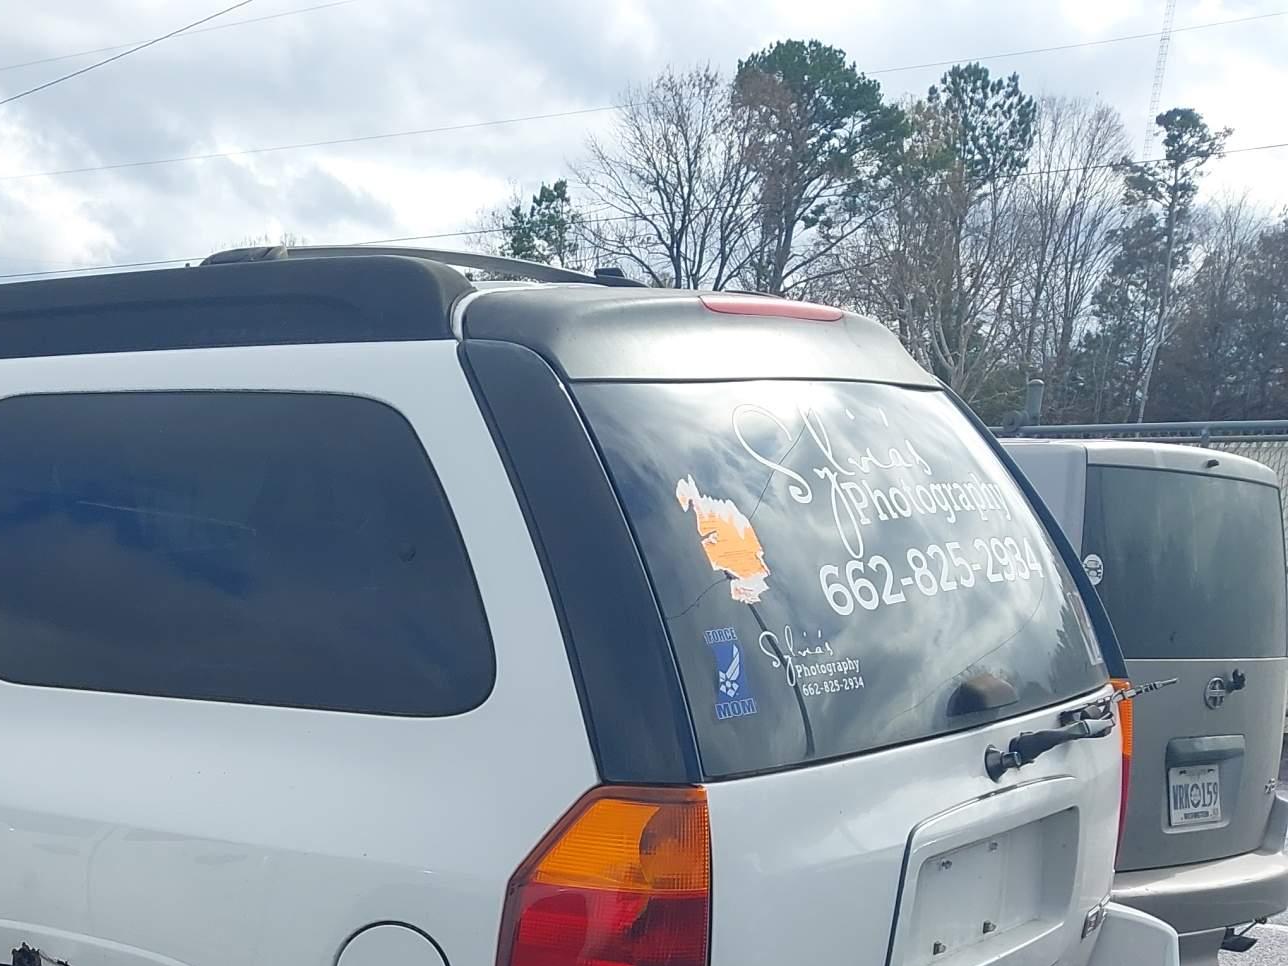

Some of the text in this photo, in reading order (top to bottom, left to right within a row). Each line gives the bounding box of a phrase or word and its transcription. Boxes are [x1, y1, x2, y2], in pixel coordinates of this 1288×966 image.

[840, 473, 1012, 525] Photography
[819, 537, 1044, 616] 662-825-2934
[706, 627, 737, 644] FORCE
[795, 658, 860, 679] Photography
[802, 676, 865, 697] 662-825-2934
[716, 699, 757, 720] MOM
[1202, 782, 1219, 807] 159
